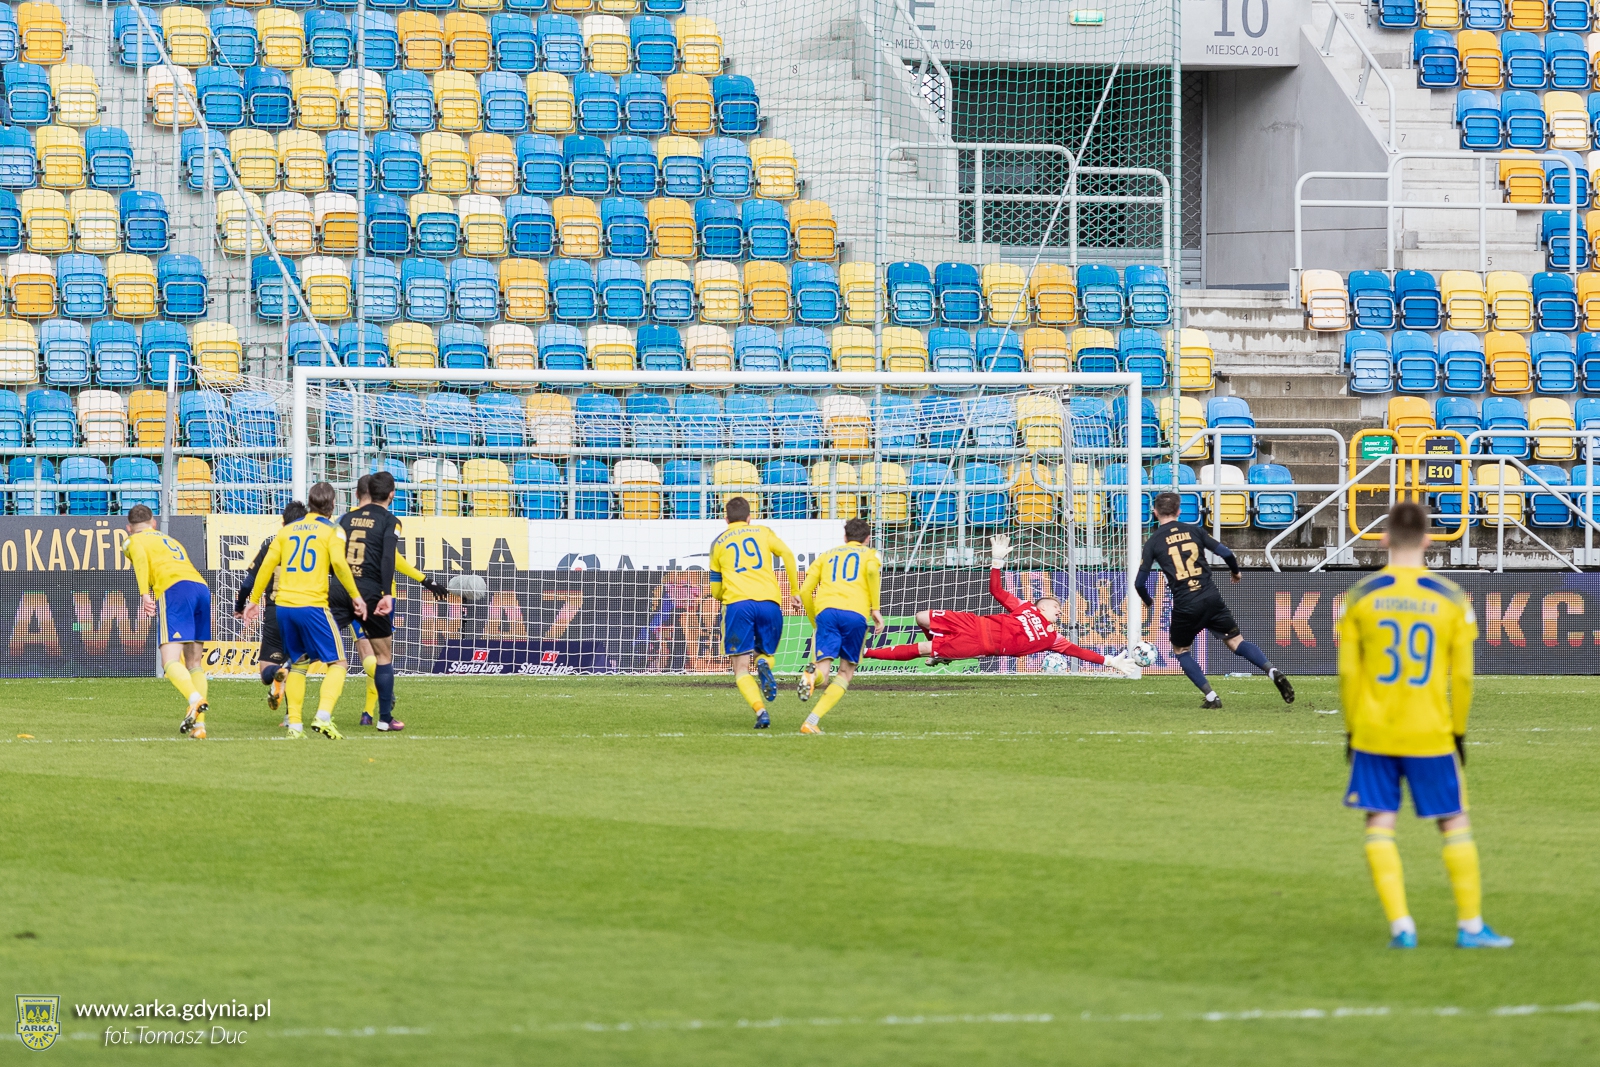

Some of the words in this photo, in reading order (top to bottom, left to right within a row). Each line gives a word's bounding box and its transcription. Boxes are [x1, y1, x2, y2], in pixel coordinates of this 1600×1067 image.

[1214, 0, 1269, 38] 10
[943, 39, 973, 50] 01-20
[1206, 45, 1249, 56] MIEJSCA
[1251, 46, 1279, 57] 20-01
[1401, 133, 1407, 142] 7
[1487, 256, 1493, 266] 5
[1285, 381, 1292, 391] 3
[1328, 448, 1335, 458] 2
[1428, 465, 1453, 479] E10
[163, 538, 185, 561] 9
[286, 535, 317, 573] 26
[346, 530, 367, 566] 6
[725, 536, 763, 574] 29
[828, 552, 860, 583] 10
[1168, 541, 1203, 581] 12
[1376, 619, 1436, 687] 39
